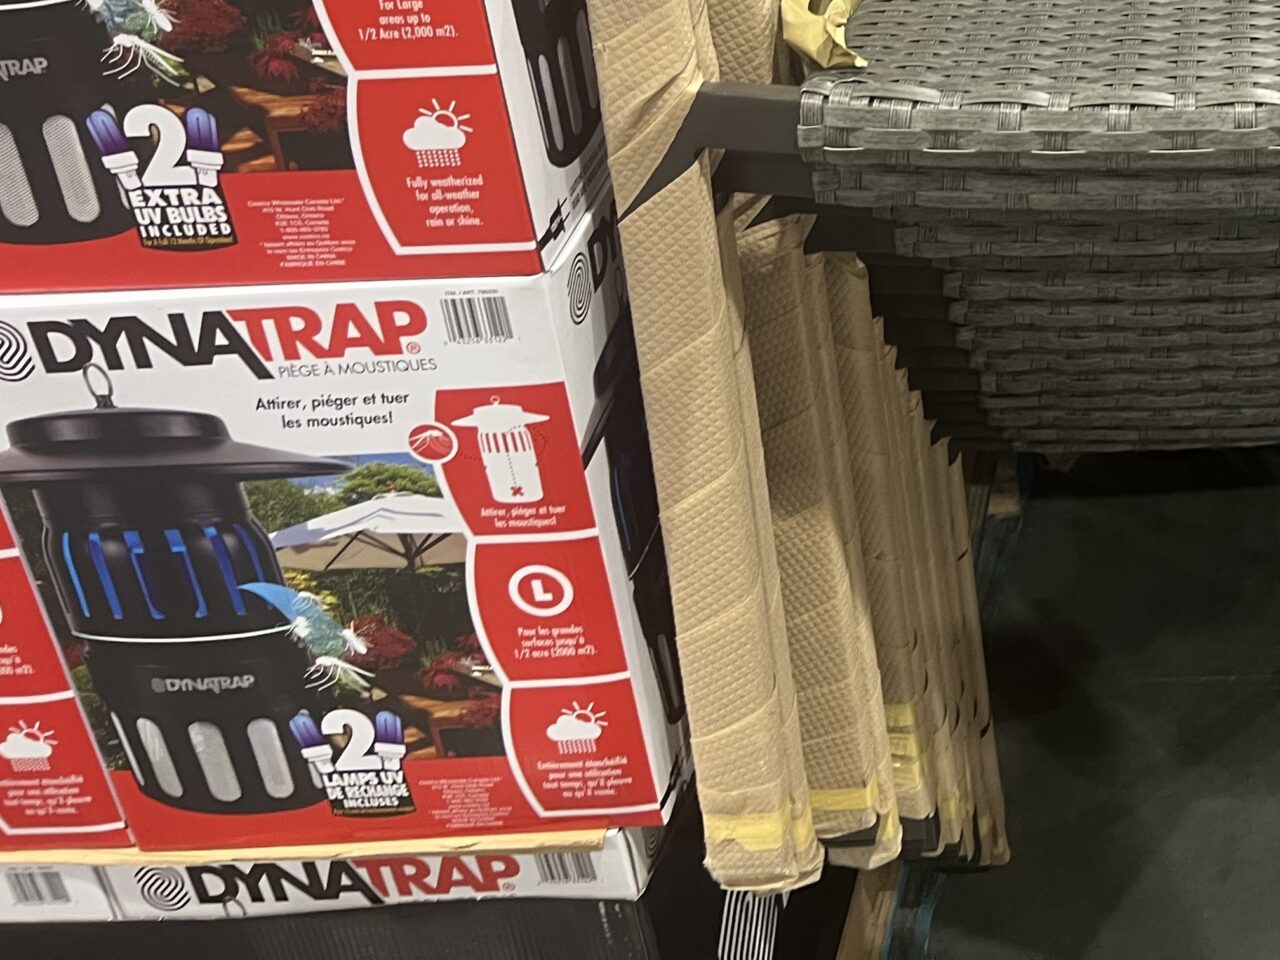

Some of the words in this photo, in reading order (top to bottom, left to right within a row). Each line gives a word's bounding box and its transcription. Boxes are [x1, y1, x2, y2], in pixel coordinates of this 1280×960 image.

[123, 103, 198, 187] 2
[128, 188, 223, 208] EXTRA
[134, 207, 161, 225] UV
[166, 205, 228, 224] BULBS
[139, 223, 232, 238] INCLUDED
[27, 300, 428, 380] DYNATRAP
[278, 364, 322, 379] PIÈGE
[324, 360, 335, 376] À
[338, 358, 438, 376] MOUSTIQUES
[256, 395, 307, 412] Attirer,
[311, 393, 360, 411] piéger
[363, 393, 377, 406] et
[380, 392, 410, 406] tuer
[282, 415, 302, 429] les
[306, 412, 393, 431] moustiques!
[530, 579, 554, 602] L
[321, 708, 383, 771] 2
[380, 771, 404, 786] UV
[327, 787, 344, 800] DE
[343, 797, 400, 809] INCLUSES
[184, 854, 521, 905] DYNATRAP
